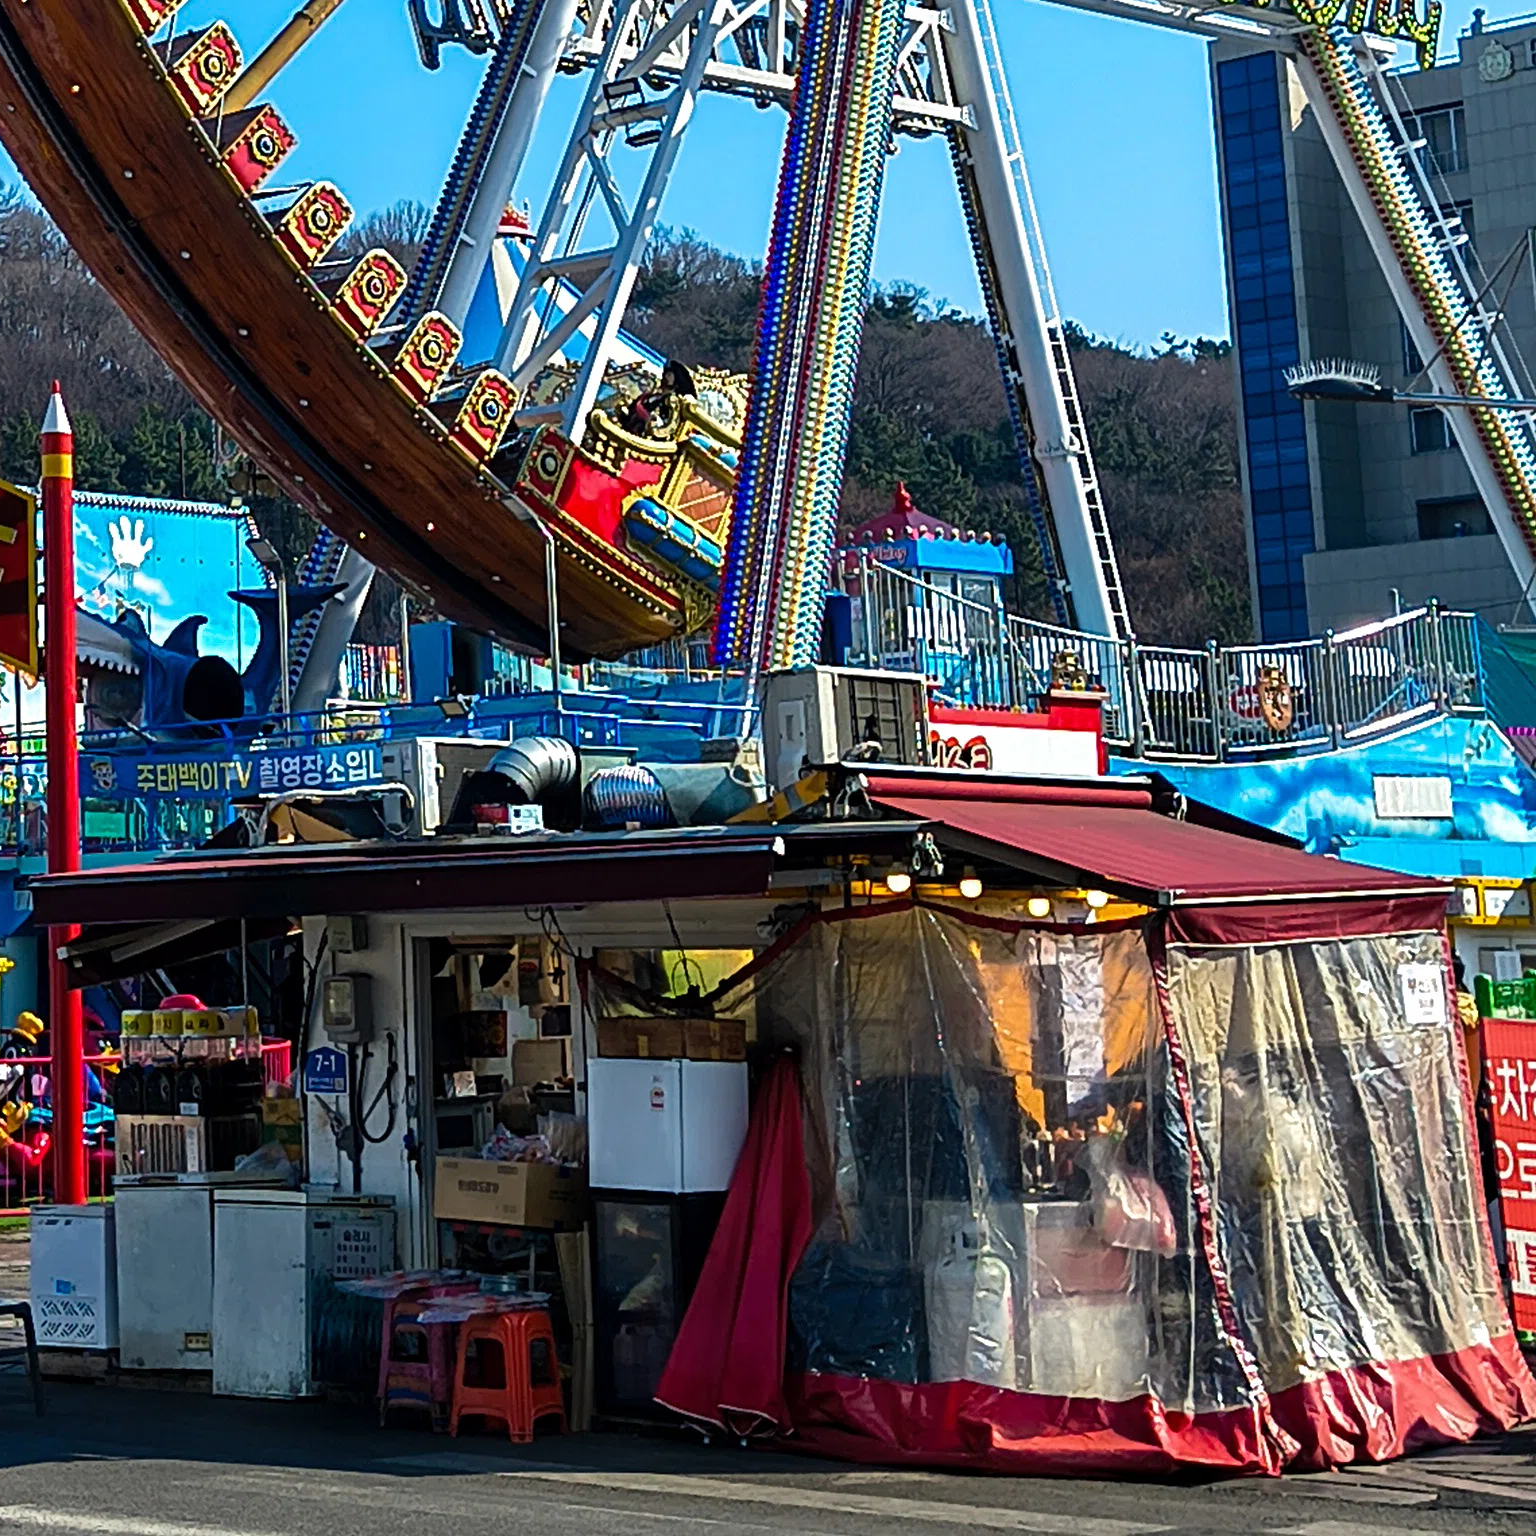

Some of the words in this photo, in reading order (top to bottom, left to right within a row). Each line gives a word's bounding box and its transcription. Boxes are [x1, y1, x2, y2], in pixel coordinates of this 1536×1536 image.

[137, 760, 253, 792] 주태백이TV
[259, 750, 383, 790] 촬영장소입
[315, 1054, 336, 1072] 7-1
